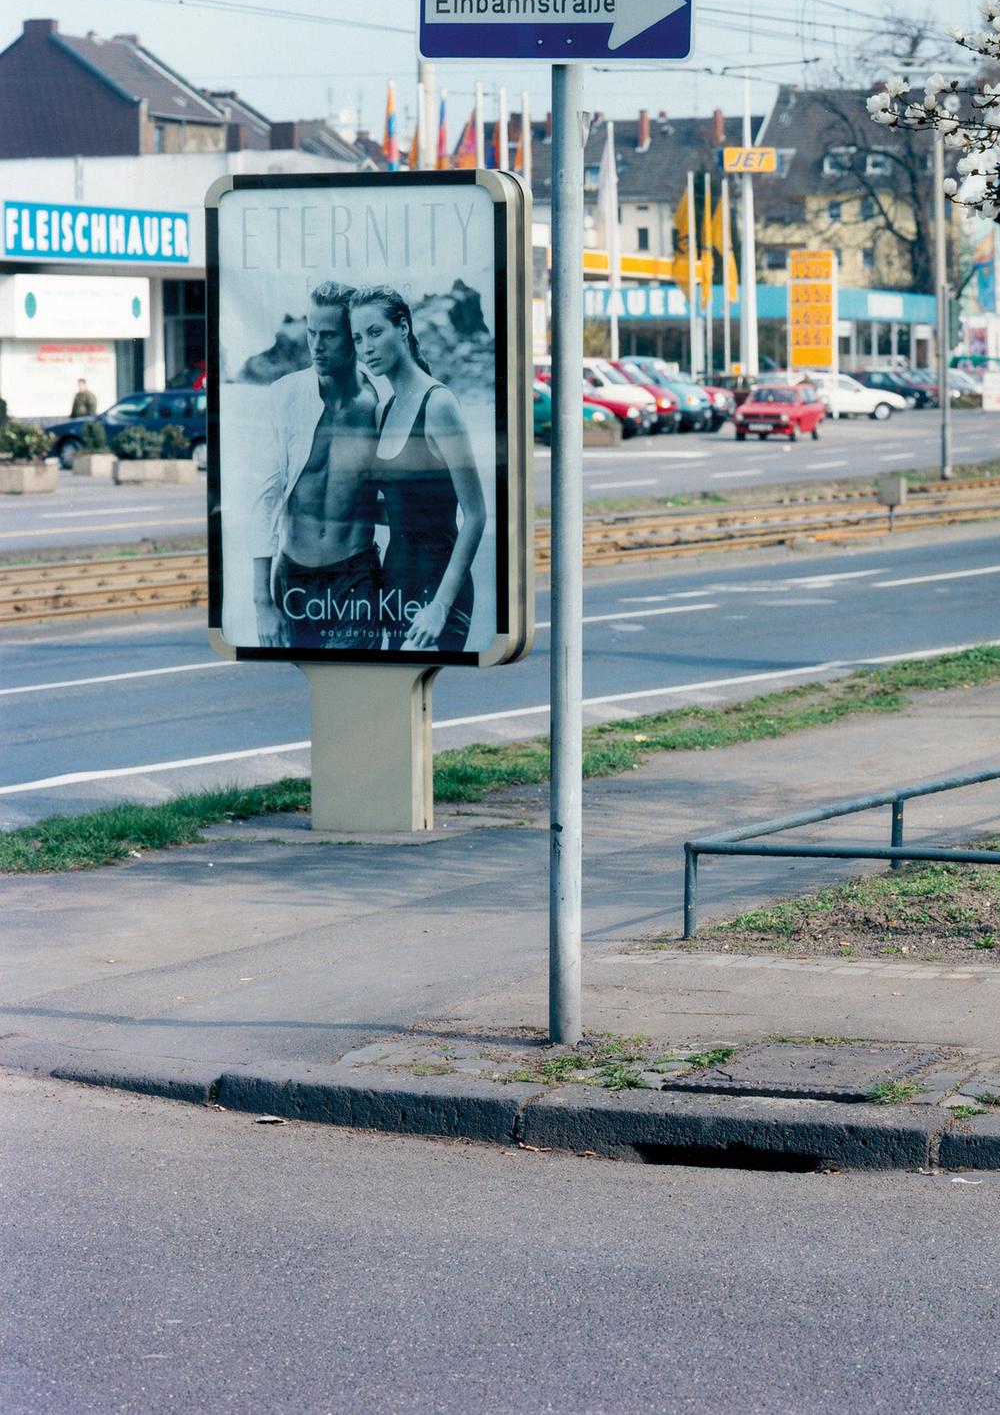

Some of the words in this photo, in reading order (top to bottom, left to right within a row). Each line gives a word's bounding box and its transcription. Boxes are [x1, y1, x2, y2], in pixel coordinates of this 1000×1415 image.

[729, 152, 770, 167] JET
[5, 207, 189, 257] FLEISCHHAUER
[241, 202, 475, 270] ETERNITY
[283, 588, 371, 621] Calvin
